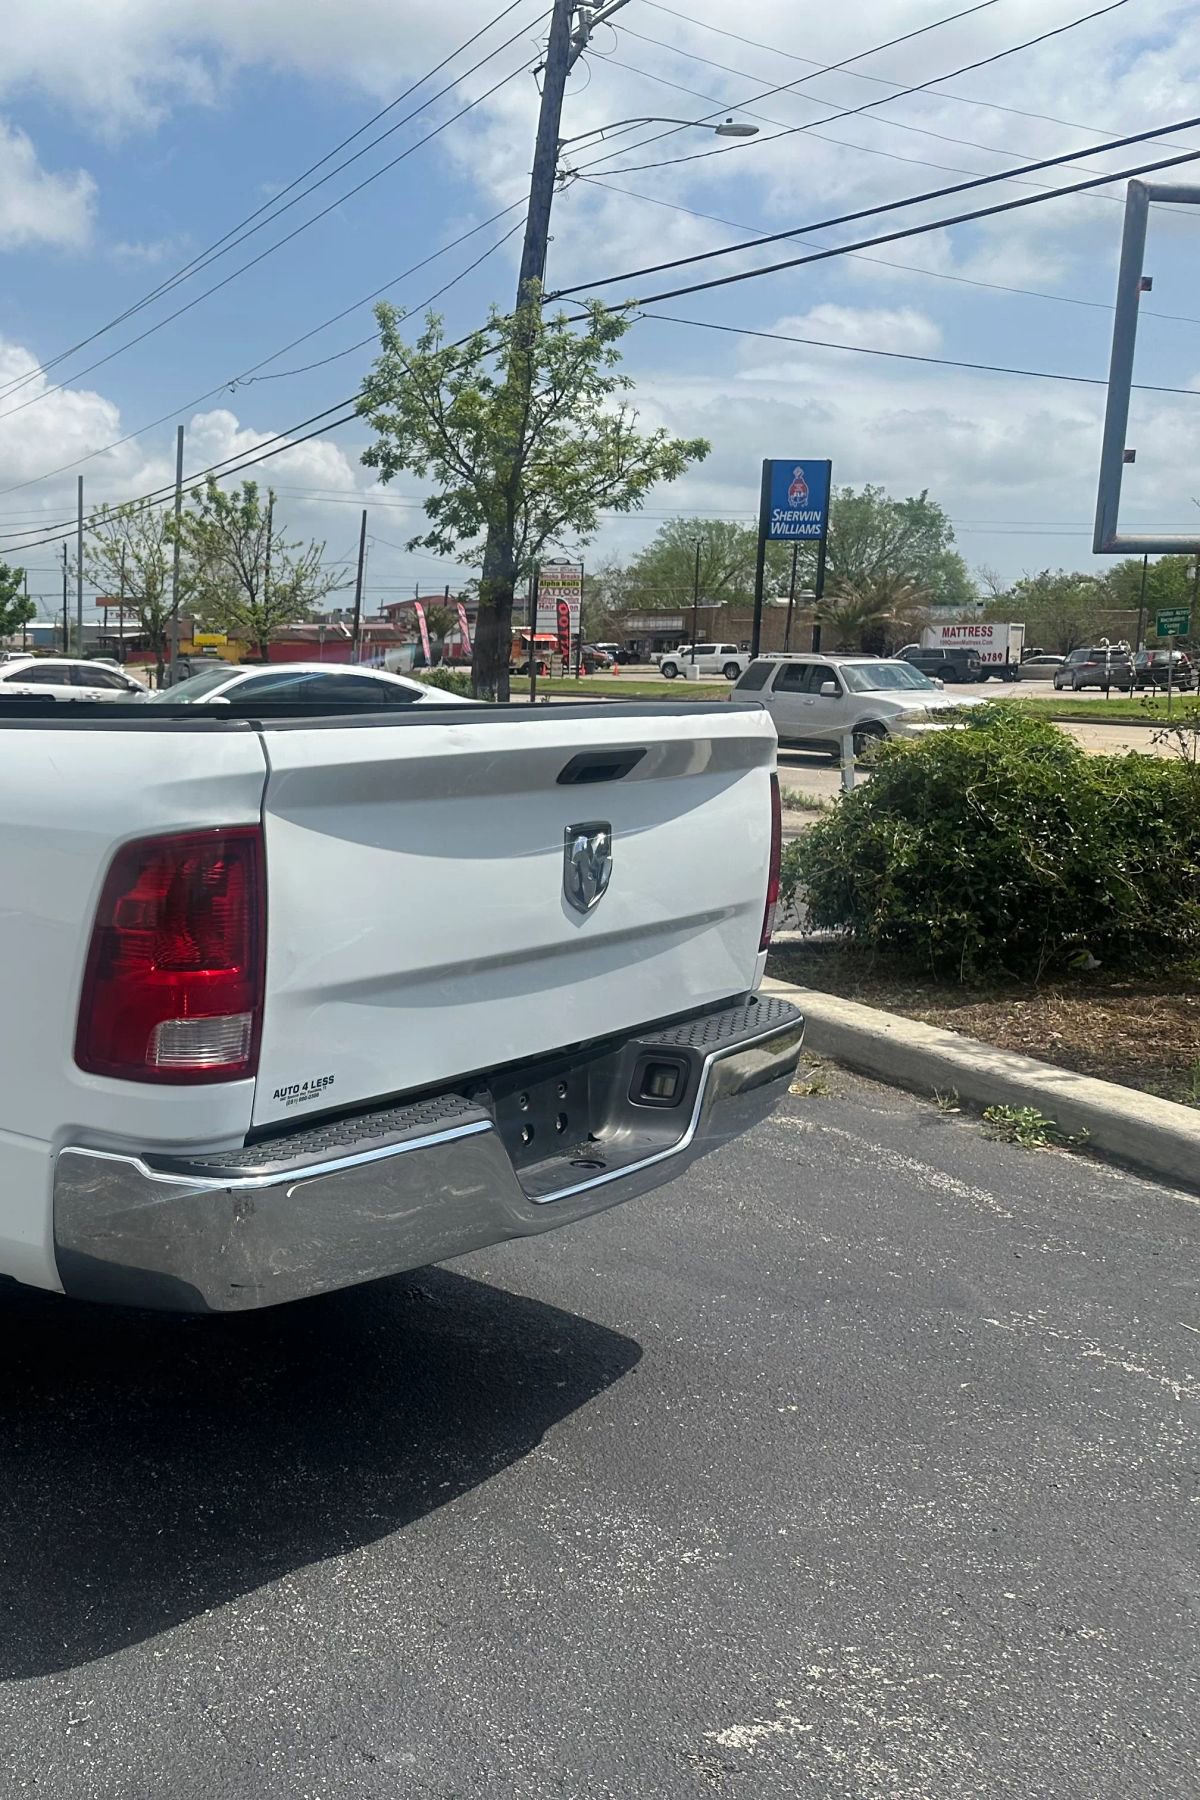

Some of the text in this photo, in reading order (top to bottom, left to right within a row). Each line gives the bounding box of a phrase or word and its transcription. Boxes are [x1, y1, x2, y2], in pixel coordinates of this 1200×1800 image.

[772, 509, 822, 521] SHERWIN
[771, 522, 822, 535] WILLIAMS
[539, 588, 579, 596] TATTOO
[538, 602, 555, 610] Hair
[942, 625, 994, 638] MATTRESS
[273, 1084, 299, 1099] AUTO
[302, 1082, 308, 1091] 4
[311, 1075, 334, 1089] LESS
